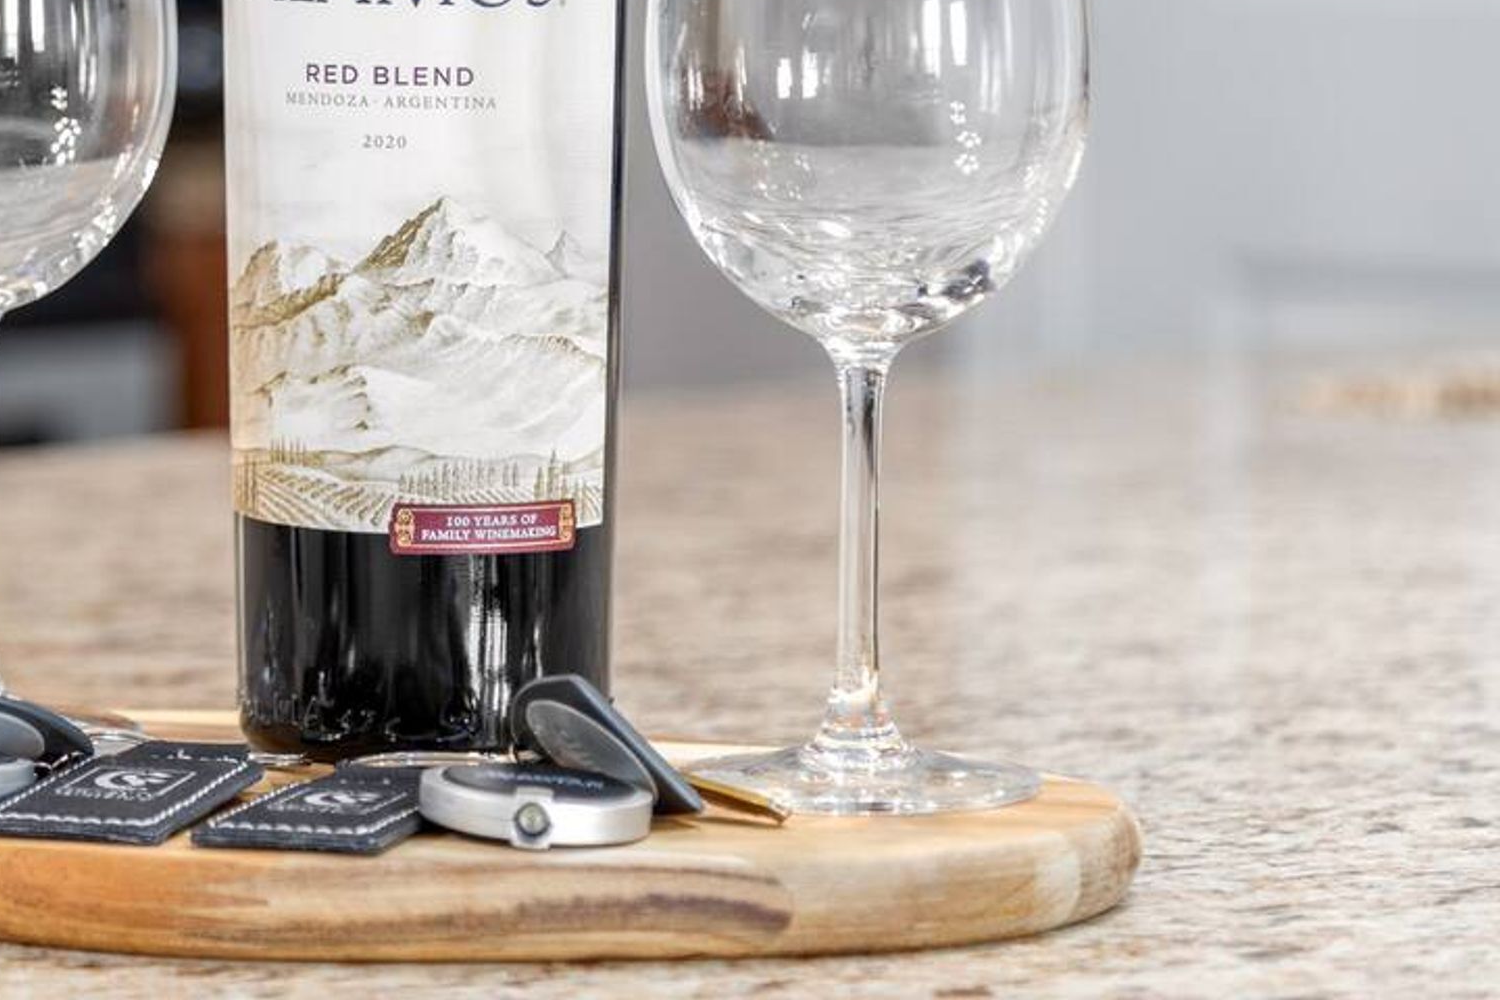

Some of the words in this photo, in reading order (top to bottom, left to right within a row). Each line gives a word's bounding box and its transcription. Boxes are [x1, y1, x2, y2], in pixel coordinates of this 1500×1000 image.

[306, 63, 359, 85] RED
[373, 65, 474, 87] BLEND
[286, 91, 369, 108] MENDOZA
[384, 95, 497, 110] ARGENTINA
[362, 134, 408, 150] 2020
[447, 516, 470, 527] 100
[473, 514, 518, 527] YEARS
[520, 513, 538, 525] OF
[421, 528, 471, 541] FAMILY
[474, 525, 557, 540] WINEMAKING
